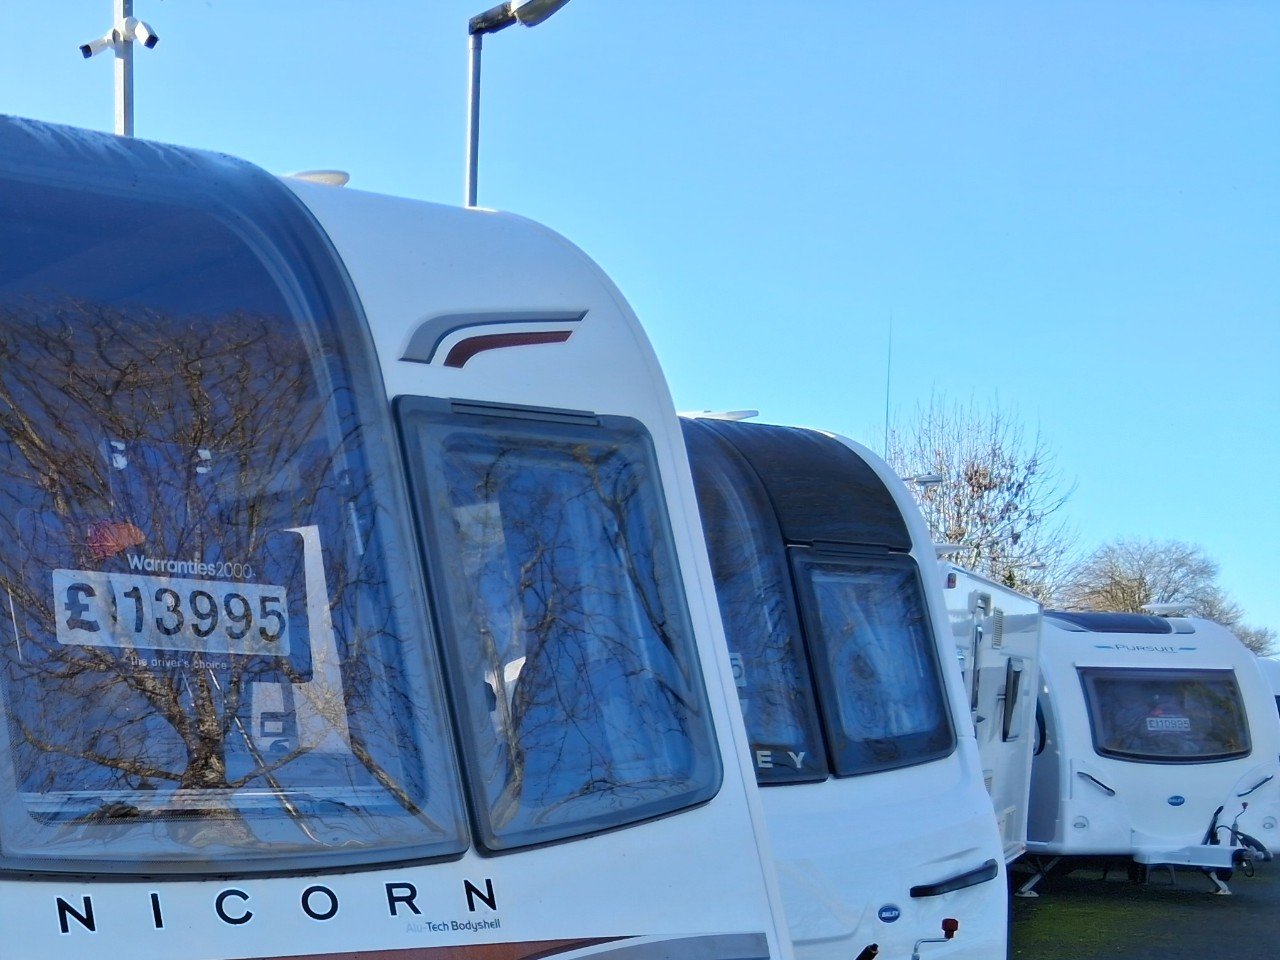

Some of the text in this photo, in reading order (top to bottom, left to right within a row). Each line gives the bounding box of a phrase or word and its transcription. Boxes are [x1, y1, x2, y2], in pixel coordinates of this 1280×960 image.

[151, 657, 190, 669] driver's
[192, 658, 228, 671] choice
[451, 918, 501, 933] Bodyshell
